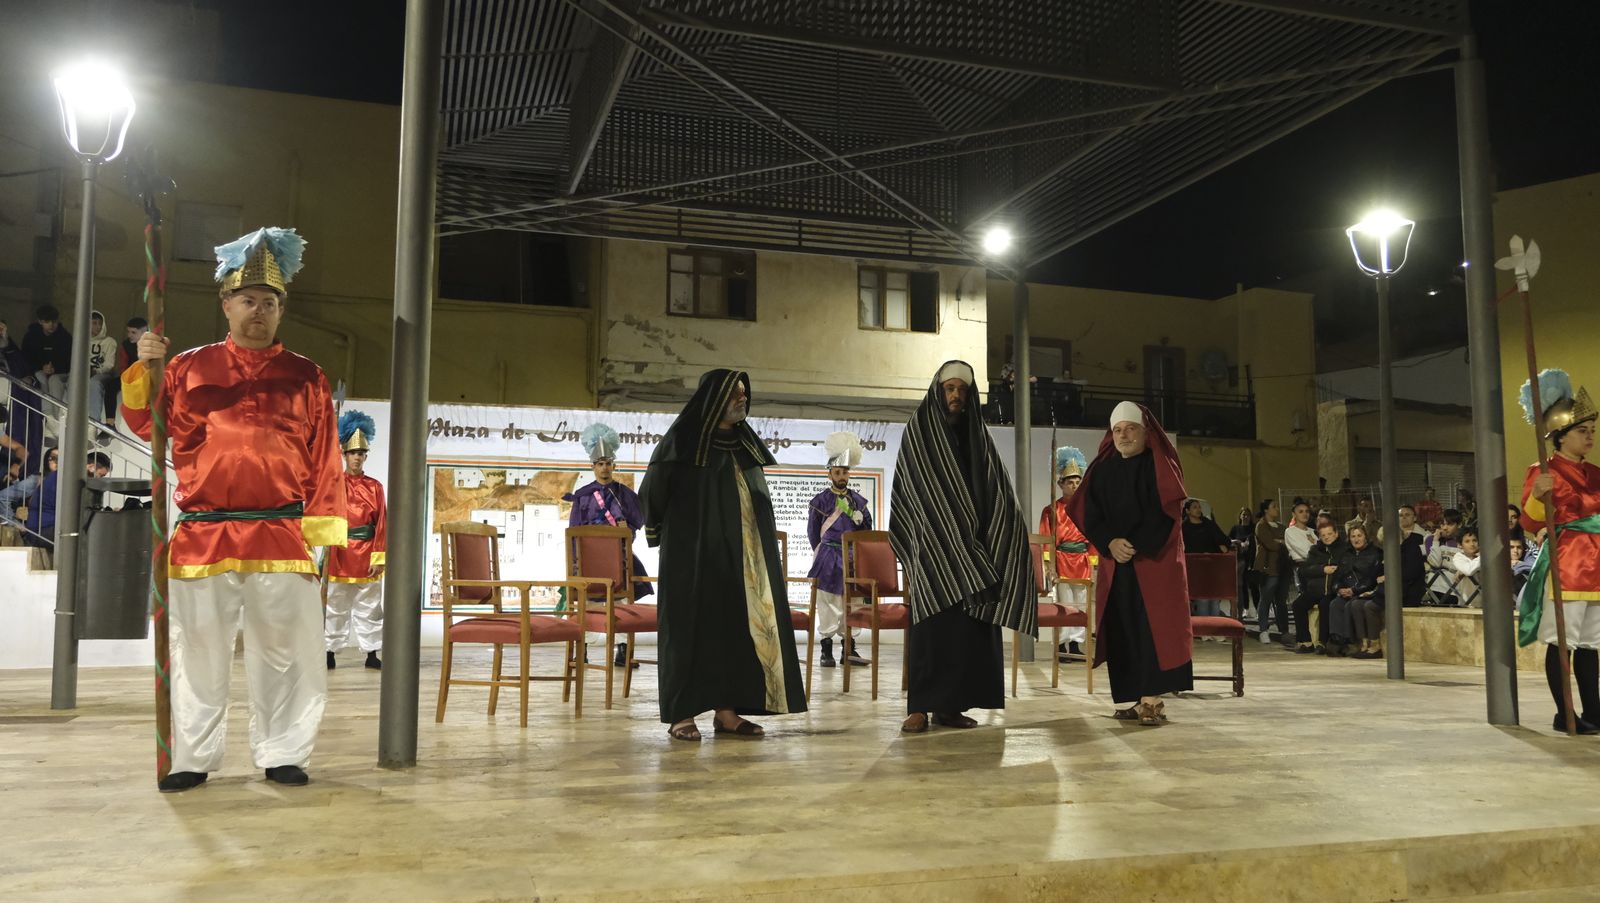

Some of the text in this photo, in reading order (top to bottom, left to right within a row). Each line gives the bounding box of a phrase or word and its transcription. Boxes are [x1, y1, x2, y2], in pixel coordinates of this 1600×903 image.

[427, 417, 489, 440] Plaza
[502, 422, 525, 440] de
[619, 425, 664, 444] mita
